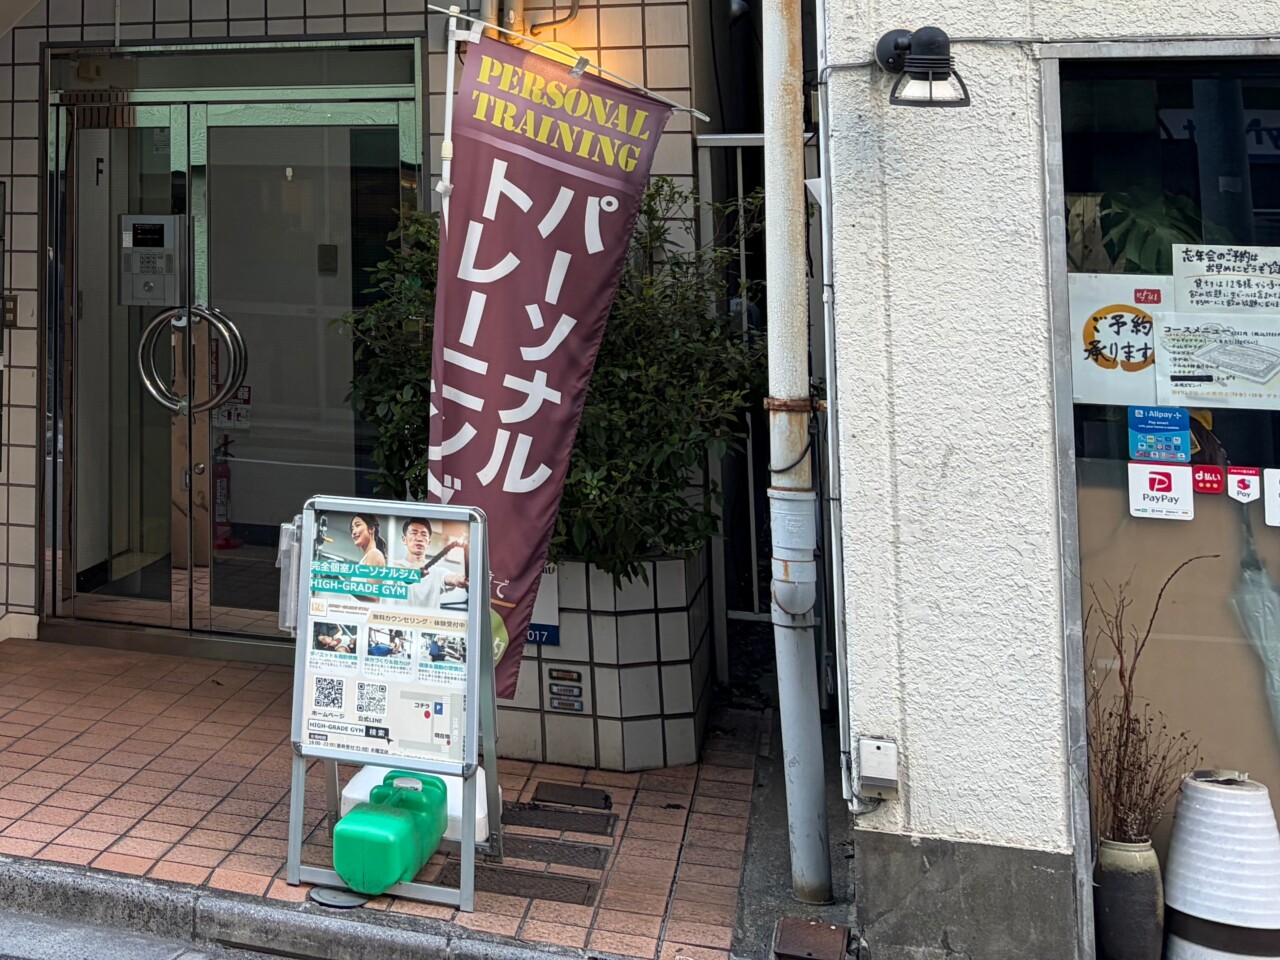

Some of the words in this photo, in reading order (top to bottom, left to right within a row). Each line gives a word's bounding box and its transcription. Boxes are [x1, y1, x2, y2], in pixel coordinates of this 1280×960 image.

[476, 55, 650, 140] PERSONAL
[472, 90, 641, 172] TRAINING
[1181, 247, 1259, 264] 忘年会のご予約は
[1092, 314, 1153, 336] ご予約
[1163, 326, 1230, 335] コースメニュー
[476, 185, 619, 494] パーソナル
[1195, 471, 1221, 481] d払い
[1142, 493, 1180, 504] PayPay
[1236, 490, 1251, 498] Pay
[310, 561, 419, 580] 完全個室パーソナルジム
[310, 580, 379, 594] HIGH-GRADE
[382, 585, 406, 596] GYM
[311, 710, 345, 720] ホームページ
[309, 722, 349, 732] HIGH-GRADE
